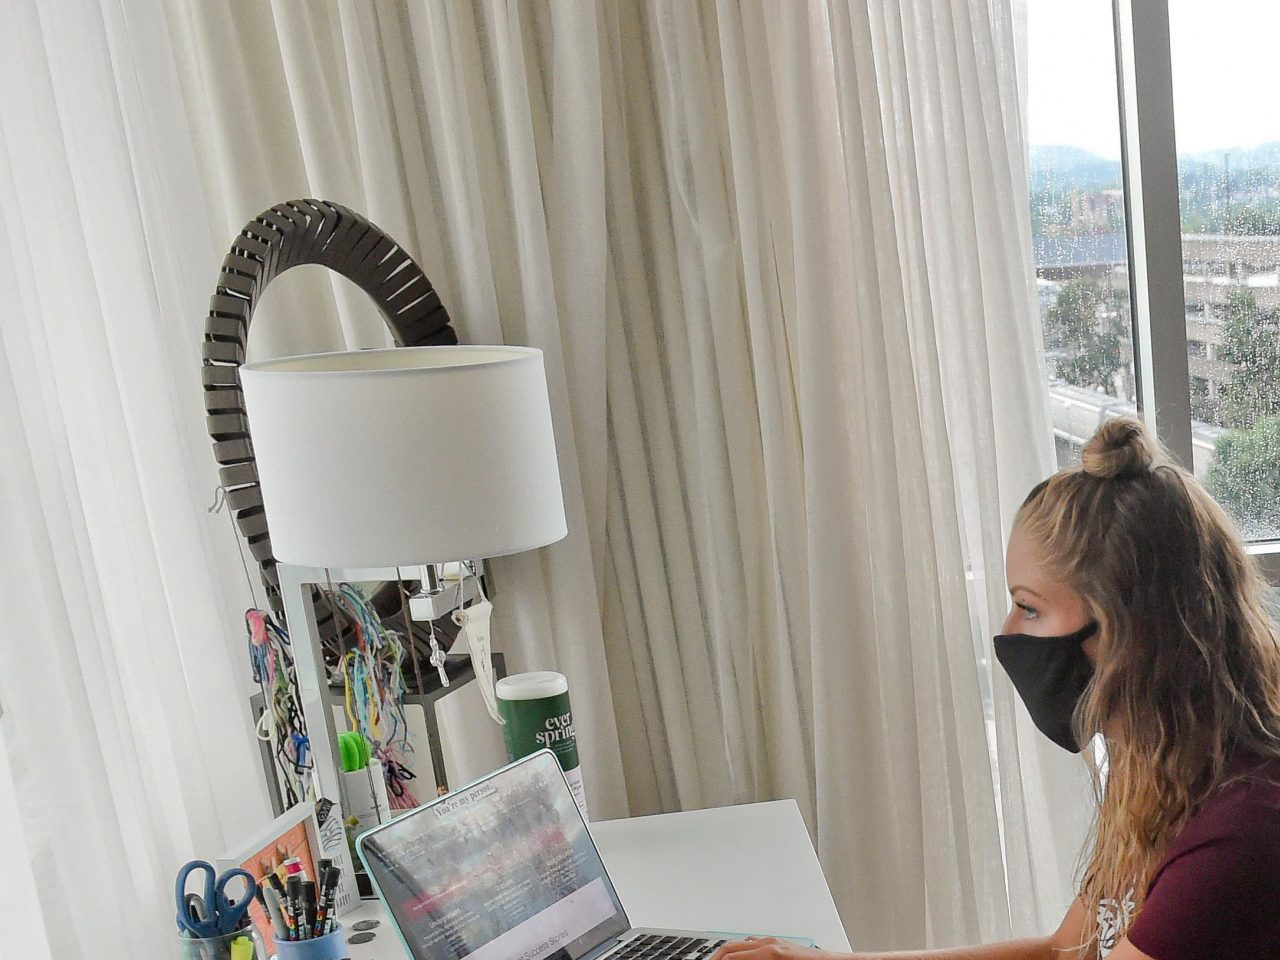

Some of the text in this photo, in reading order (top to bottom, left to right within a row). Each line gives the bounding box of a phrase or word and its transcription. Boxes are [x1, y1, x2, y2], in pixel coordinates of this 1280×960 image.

[545, 711, 572, 730] ever
[435, 801, 459, 817] You're
[459, 796, 470, 806] my
[524, 941, 550, 960] Success
